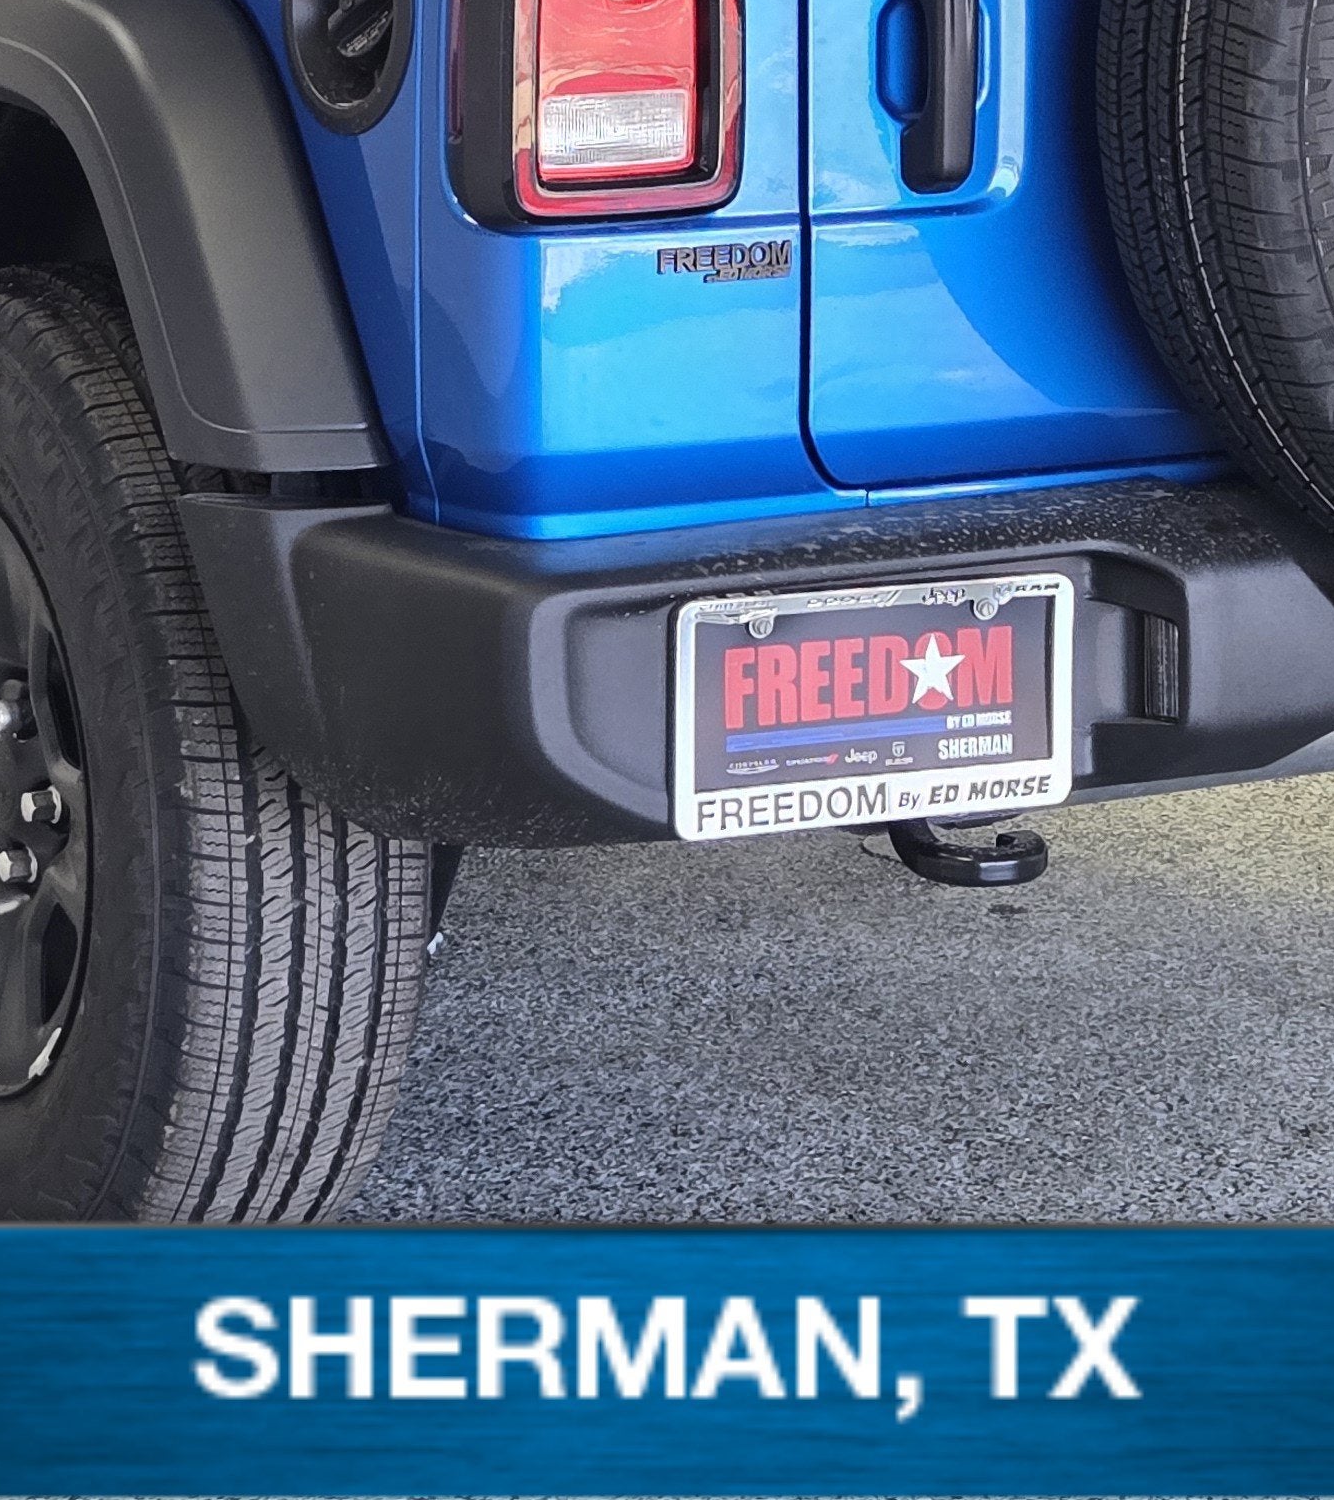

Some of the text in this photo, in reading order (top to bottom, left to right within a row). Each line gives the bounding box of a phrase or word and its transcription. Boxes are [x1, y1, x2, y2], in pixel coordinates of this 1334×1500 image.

[657, 239, 793, 276] FREEDOM
[724, 625, 1014, 730] FREEDOM
[844, 748, 878, 765] Jeep
[937, 733, 1013, 761] SHERMAN
[696, 774, 1052, 833] FREEDOM By ED MORSE
